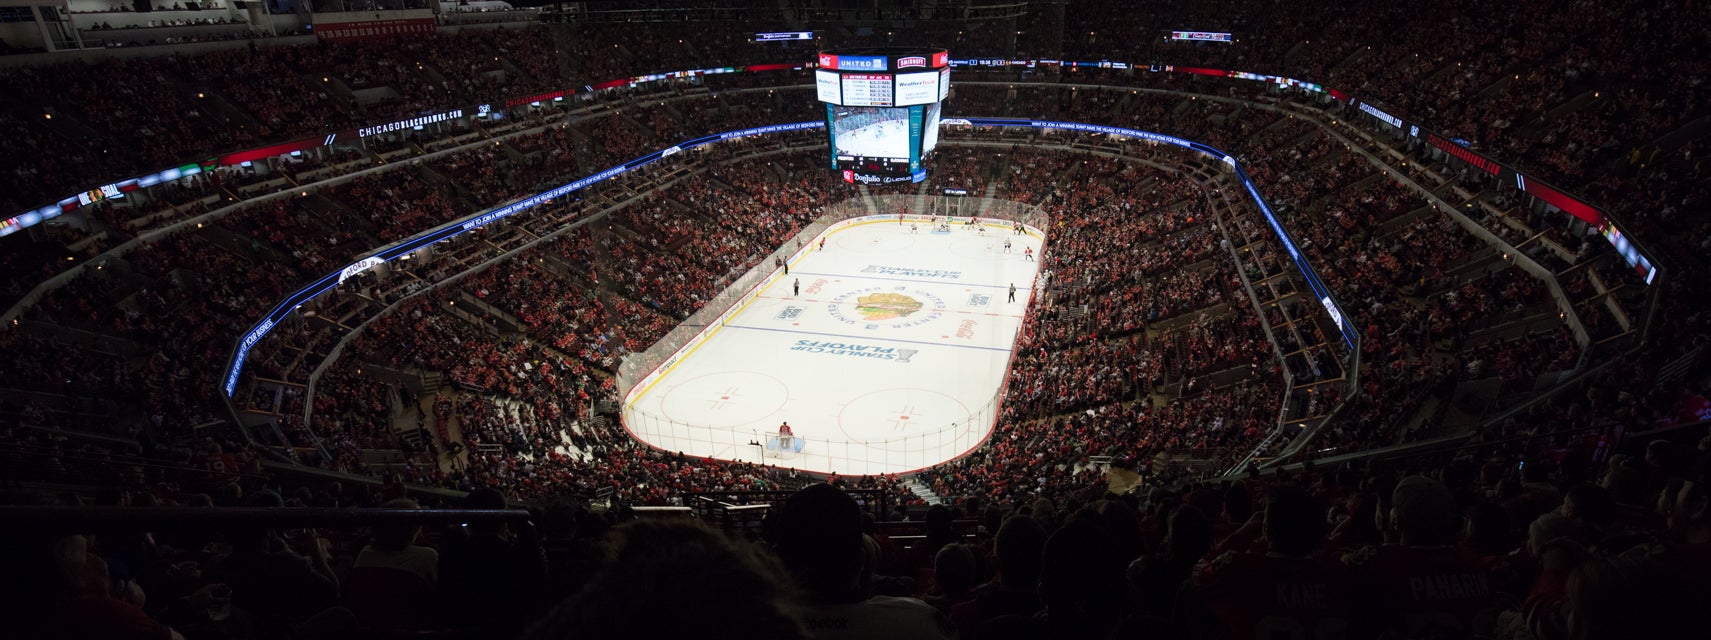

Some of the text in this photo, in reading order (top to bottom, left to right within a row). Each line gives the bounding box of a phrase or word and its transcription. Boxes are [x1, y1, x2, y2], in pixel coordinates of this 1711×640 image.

[359, 110, 462, 138] CHICAGOBLACKHAWKS.COM
[790, 346, 896, 360] STANLEY CUP
[795, 340, 894, 354] PLAYOFFS
[1275, 584, 1328, 608] KANE
